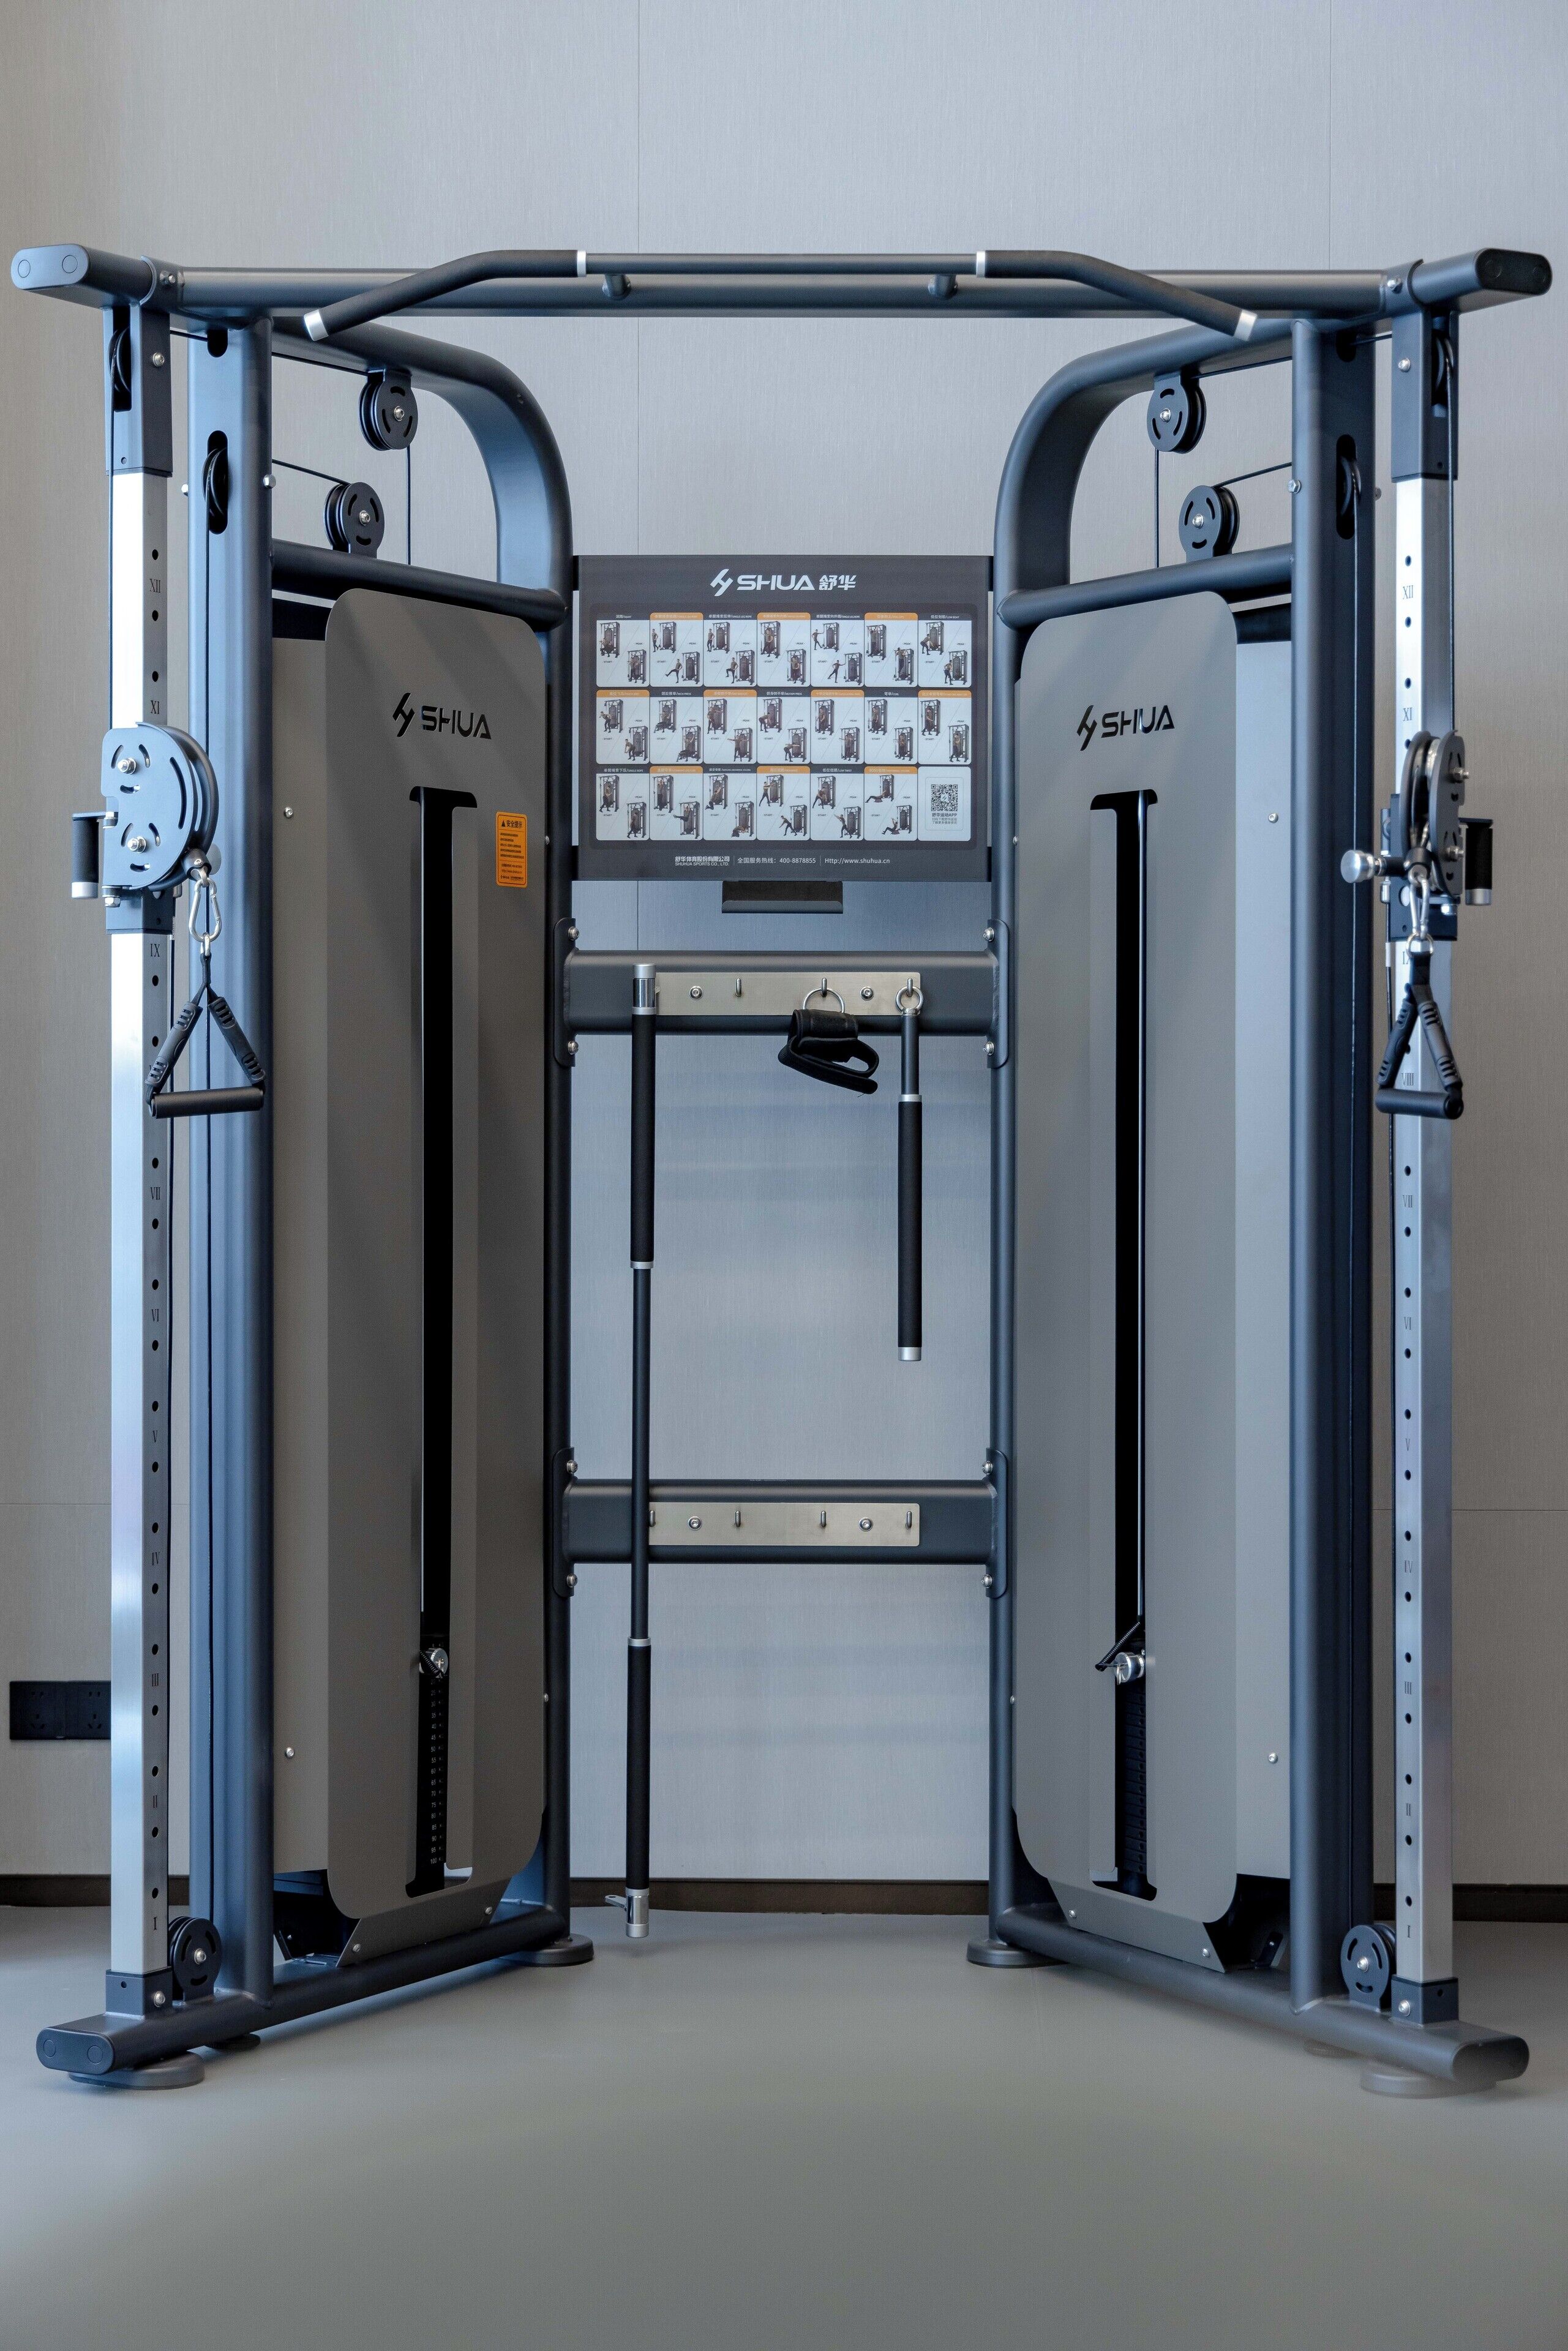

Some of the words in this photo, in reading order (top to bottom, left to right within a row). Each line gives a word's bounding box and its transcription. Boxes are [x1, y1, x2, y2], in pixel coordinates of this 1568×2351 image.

[150, 579, 160, 593] XII
[737, 576, 815, 590] SHUA
[819, 575, 856, 590] 舒华
[1403, 585, 1413, 599] XII
[151, 700, 159, 714] XI
[1403, 708, 1412, 721] XI
[421, 705, 492, 740] SHUA
[1101, 705, 1175, 738] SHUA
[506, 820, 522, 828] 安全提示
[151, 943, 160, 957] IX
[1401, 1073, 1414, 1086] VIII
[151, 1187, 160, 1199] VII
[1403, 1195, 1412, 1207] VII
[152, 1309, 159, 1322] VI
[1404, 1317, 1411, 1330] VI
[153, 1431, 157, 1442] V
[1406, 1439, 1409, 1451] V
[152, 1552, 160, 1565] IV
[1405, 1561, 1412, 1573] IV
[153, 1795, 157, 1808] II
[1406, 1804, 1411, 1816] II
